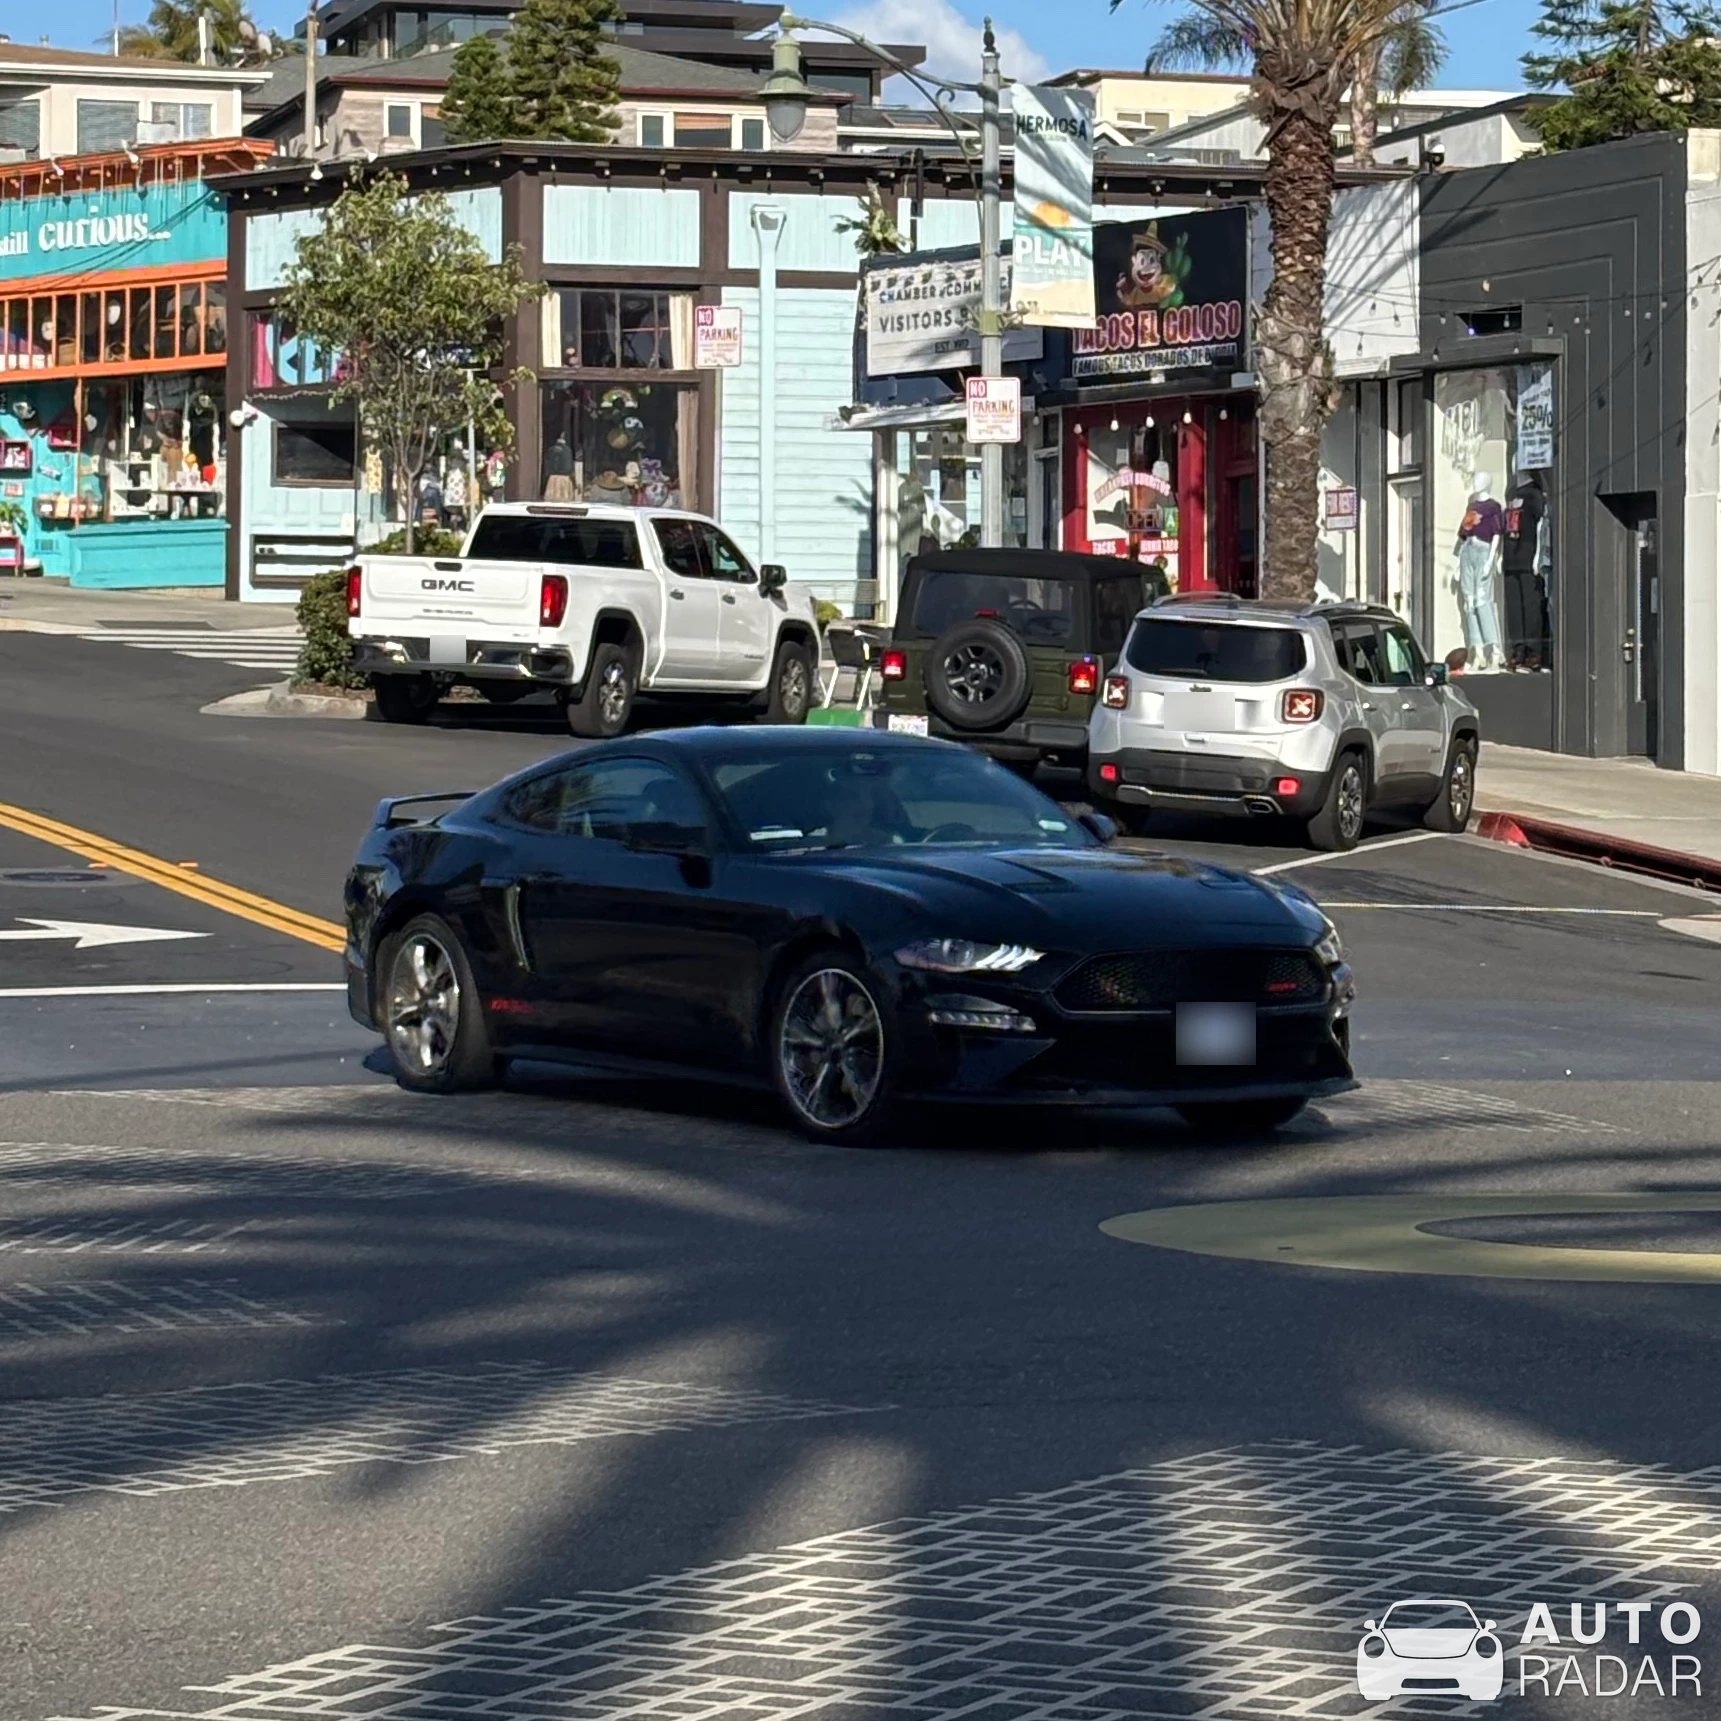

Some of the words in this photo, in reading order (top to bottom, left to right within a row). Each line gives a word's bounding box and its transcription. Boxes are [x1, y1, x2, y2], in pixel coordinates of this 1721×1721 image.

[1016, 114, 1088, 141] HERMOSA
[1014, 235, 1087, 267] PLAY
[879, 284, 937, 304] CHAMBER
[880, 308, 953, 333] VISITORS
[1073, 312, 1135, 353] TACOS
[1138, 310, 1160, 347] EL
[1164, 300, 1241, 344] GOLOSO
[699, 327, 738, 341] PARKING
[1112, 351, 1143, 373] TACOS
[970, 381, 986, 397] NO
[972, 399, 1015, 414] PARKING
[1521, 402, 1554, 431] 25%
[1125, 511, 1161, 528] OPEN
[421, 579, 475, 592] GMC
